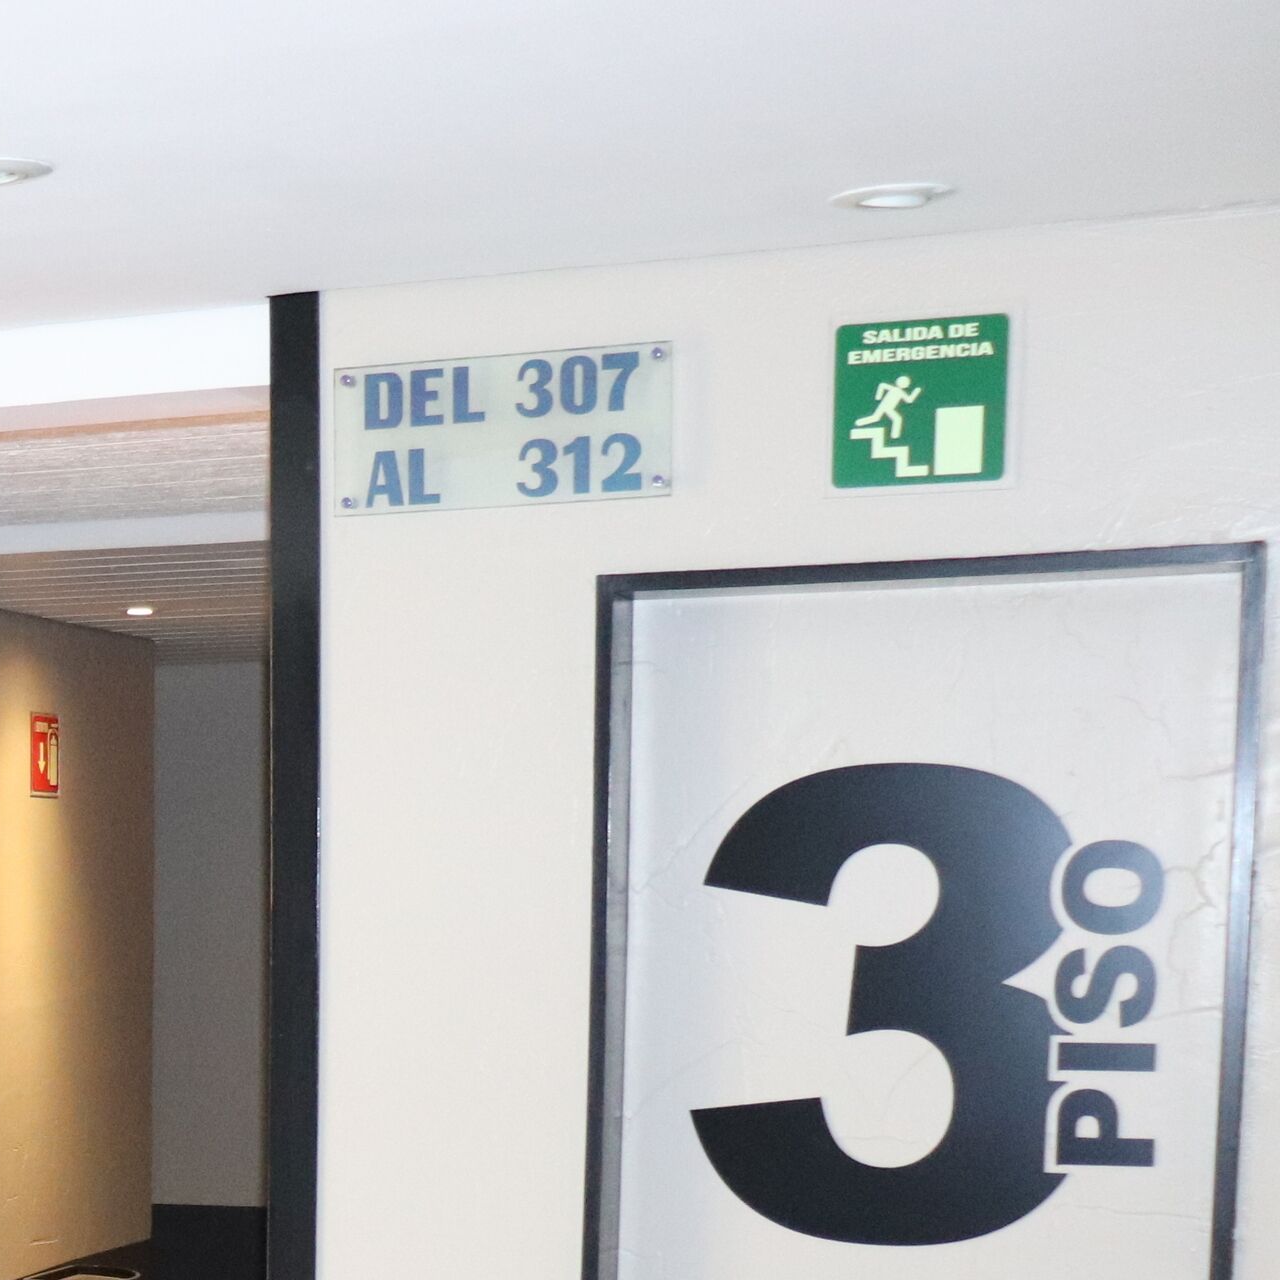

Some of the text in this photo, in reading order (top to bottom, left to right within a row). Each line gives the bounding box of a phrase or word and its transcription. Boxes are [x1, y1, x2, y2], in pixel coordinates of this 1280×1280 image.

[847, 341, 994, 365] EMERGENCIA
[862, 322, 980, 344] SALIDA DE
[364, 351, 640, 431] DEL 307
[365, 432, 643, 508] AL 312
[690, 762, 1073, 1247] 3
[1052, 839, 1165, 1168] PISO
